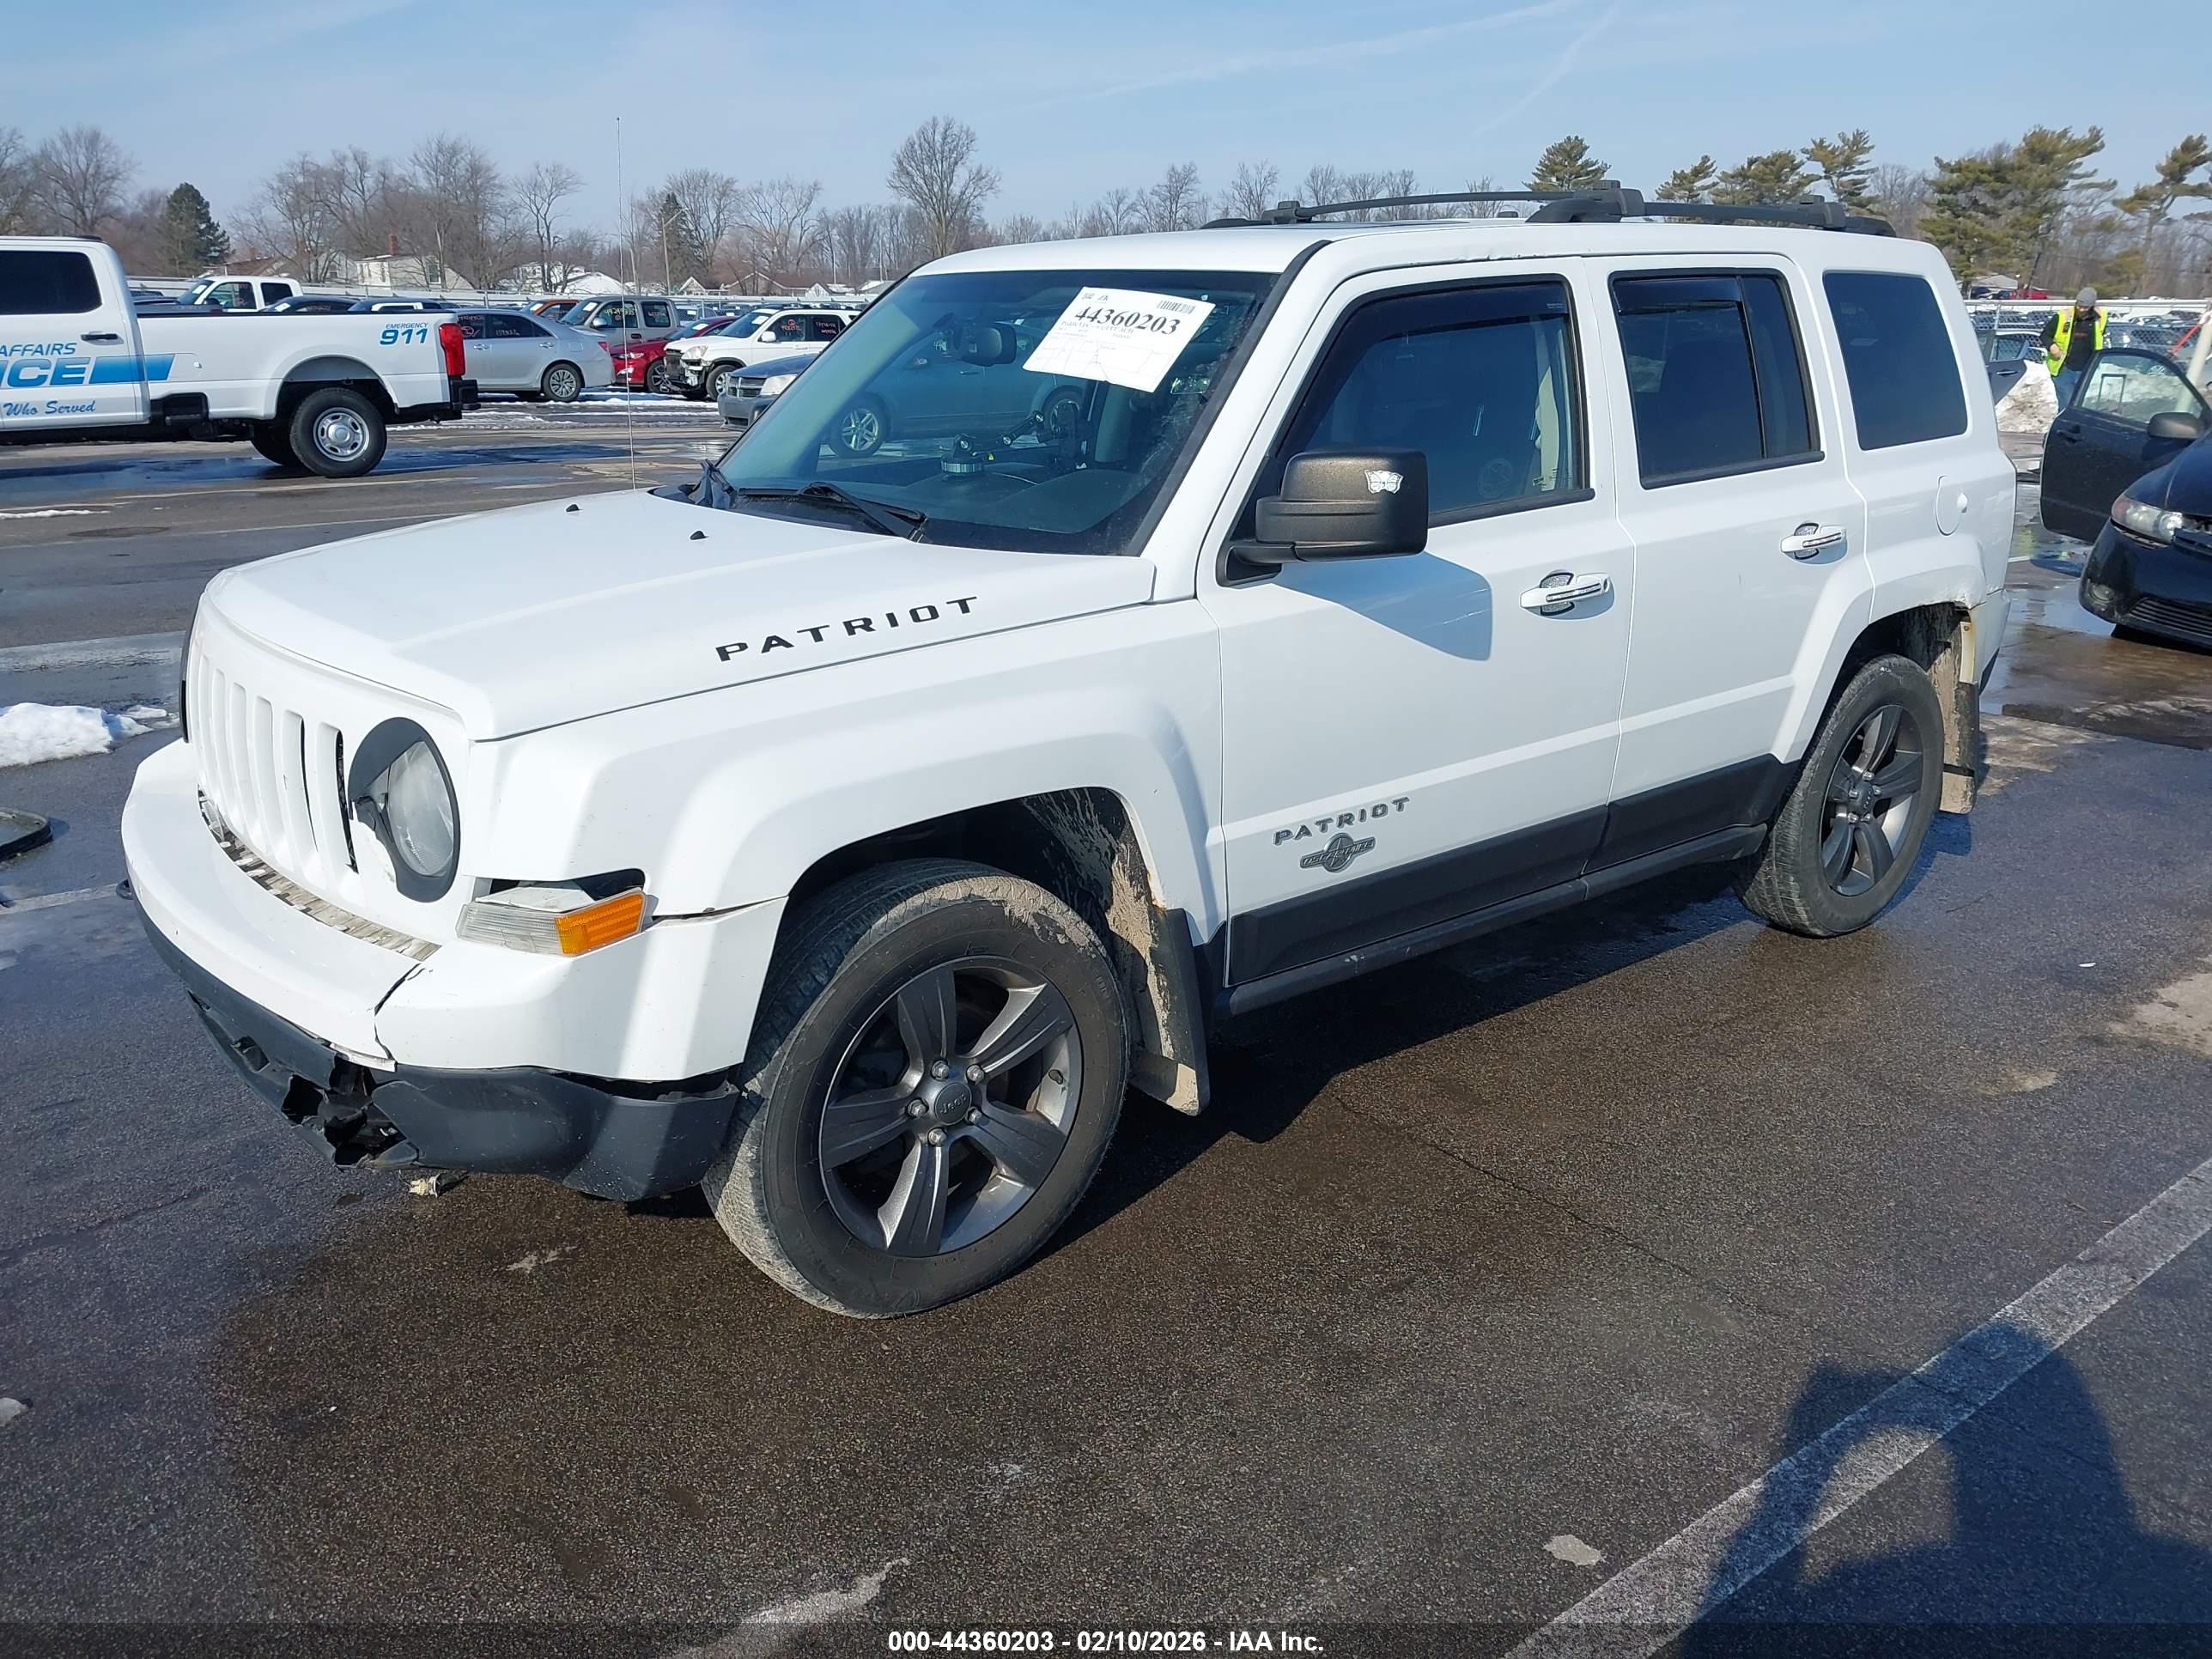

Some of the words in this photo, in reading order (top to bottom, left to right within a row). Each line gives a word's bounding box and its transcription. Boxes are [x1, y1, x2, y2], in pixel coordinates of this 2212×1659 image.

[1074, 307, 1181, 335] 44360203
[380, 328, 428, 345] 911
[0, 343, 77, 357] AFFAIRS
[3, 401, 38, 416] Who
[46, 399, 96, 415] Served
[715, 597, 977, 662] PATRIOT
[1273, 796, 1410, 846] PATRIOT
